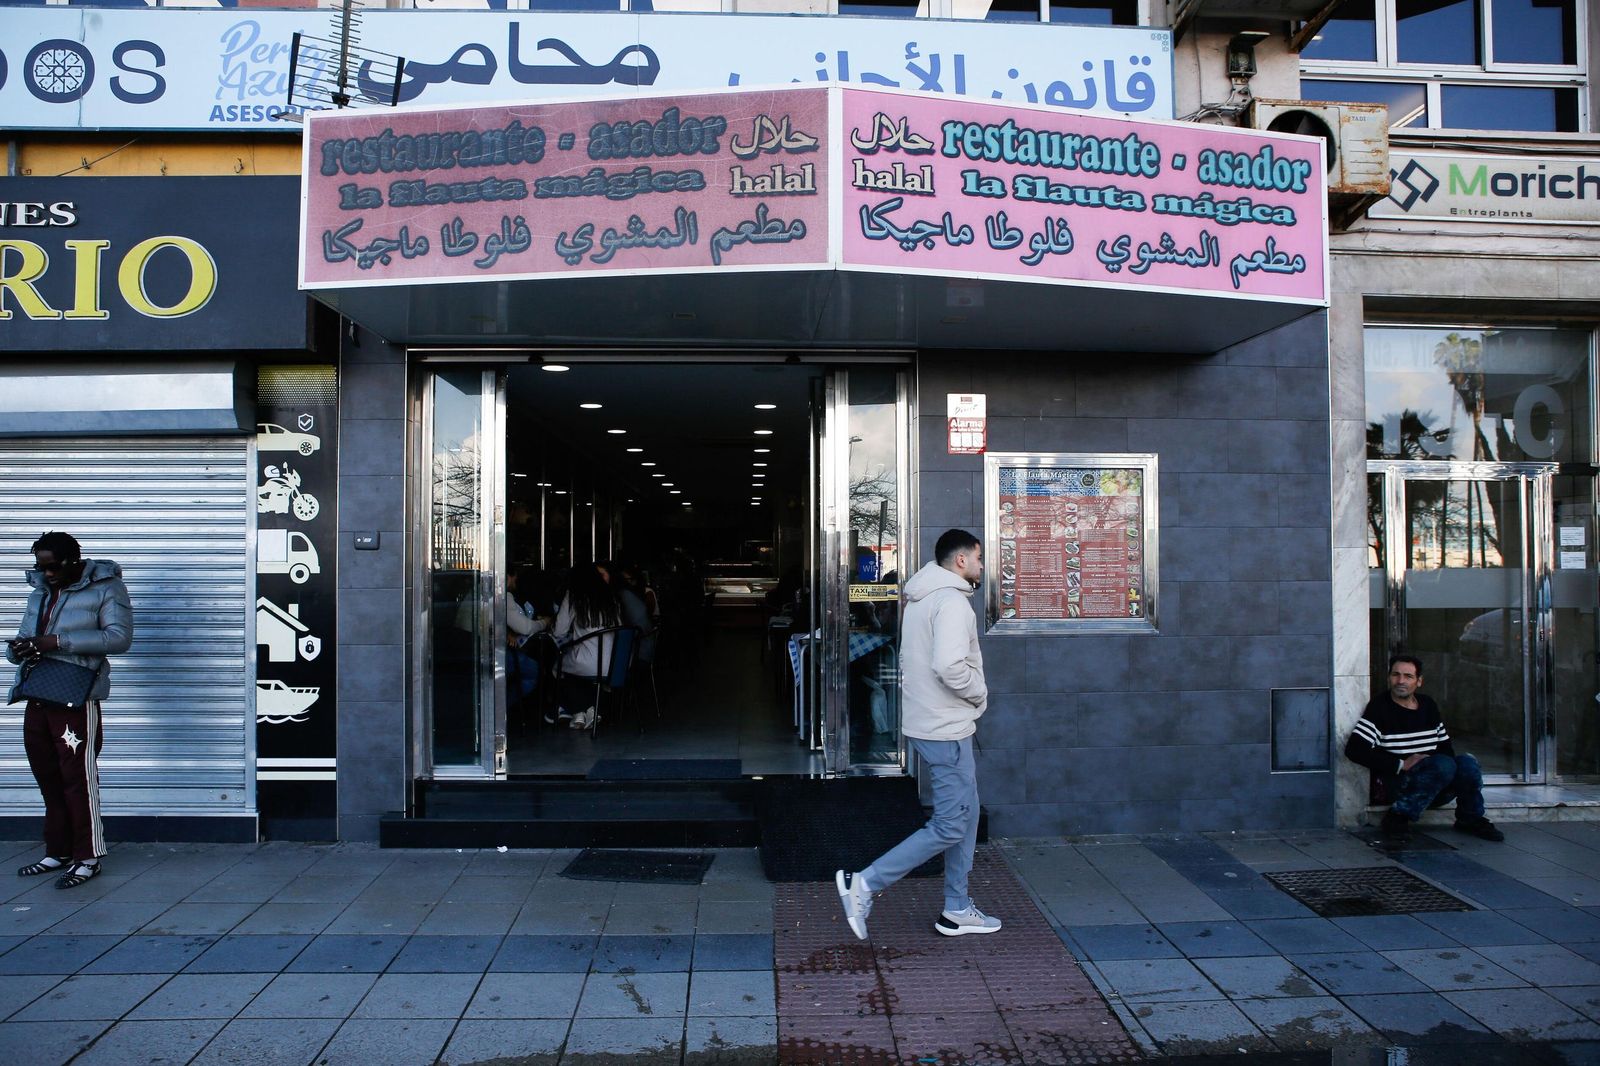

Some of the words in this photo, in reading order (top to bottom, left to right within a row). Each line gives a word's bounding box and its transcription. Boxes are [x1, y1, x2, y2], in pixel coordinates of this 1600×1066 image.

[0, 39, 167, 104] OS
[320, 120, 546, 176] restaurante
[588, 106, 727, 160] asador
[730, 114, 819, 158] حلال
[851, 112, 935, 154] حلال
[941, 118, 1160, 178] restaurante
[1198, 144, 1312, 193] asador
[339, 183, 383, 210] la
[389, 176, 528, 207] flauta
[534, 166, 706, 200] mágica
[729, 163, 818, 196] halal
[852, 158, 935, 194] halal
[961, 169, 1007, 198] la
[1013, 174, 1147, 212] flauta
[1152, 192, 1297, 226] mágica
[1448, 163, 1600, 200] Morich
[555, 206, 698, 266] المشوي
[710, 203, 807, 266] مطعم
[859, 197, 975, 251] ماجيكا
[985, 210, 1074, 266] فلوطا
[1450, 207, 1534, 218] Entreplanta
[322, 217, 429, 270] ماجيكا
[440, 215, 531, 269] فلوطا
[1096, 229, 1220, 274] المشوي
[1230, 236, 1306, 289] مطعم
[0, 236, 218, 321] RIO
[950, 418, 983, 428] Alarma
